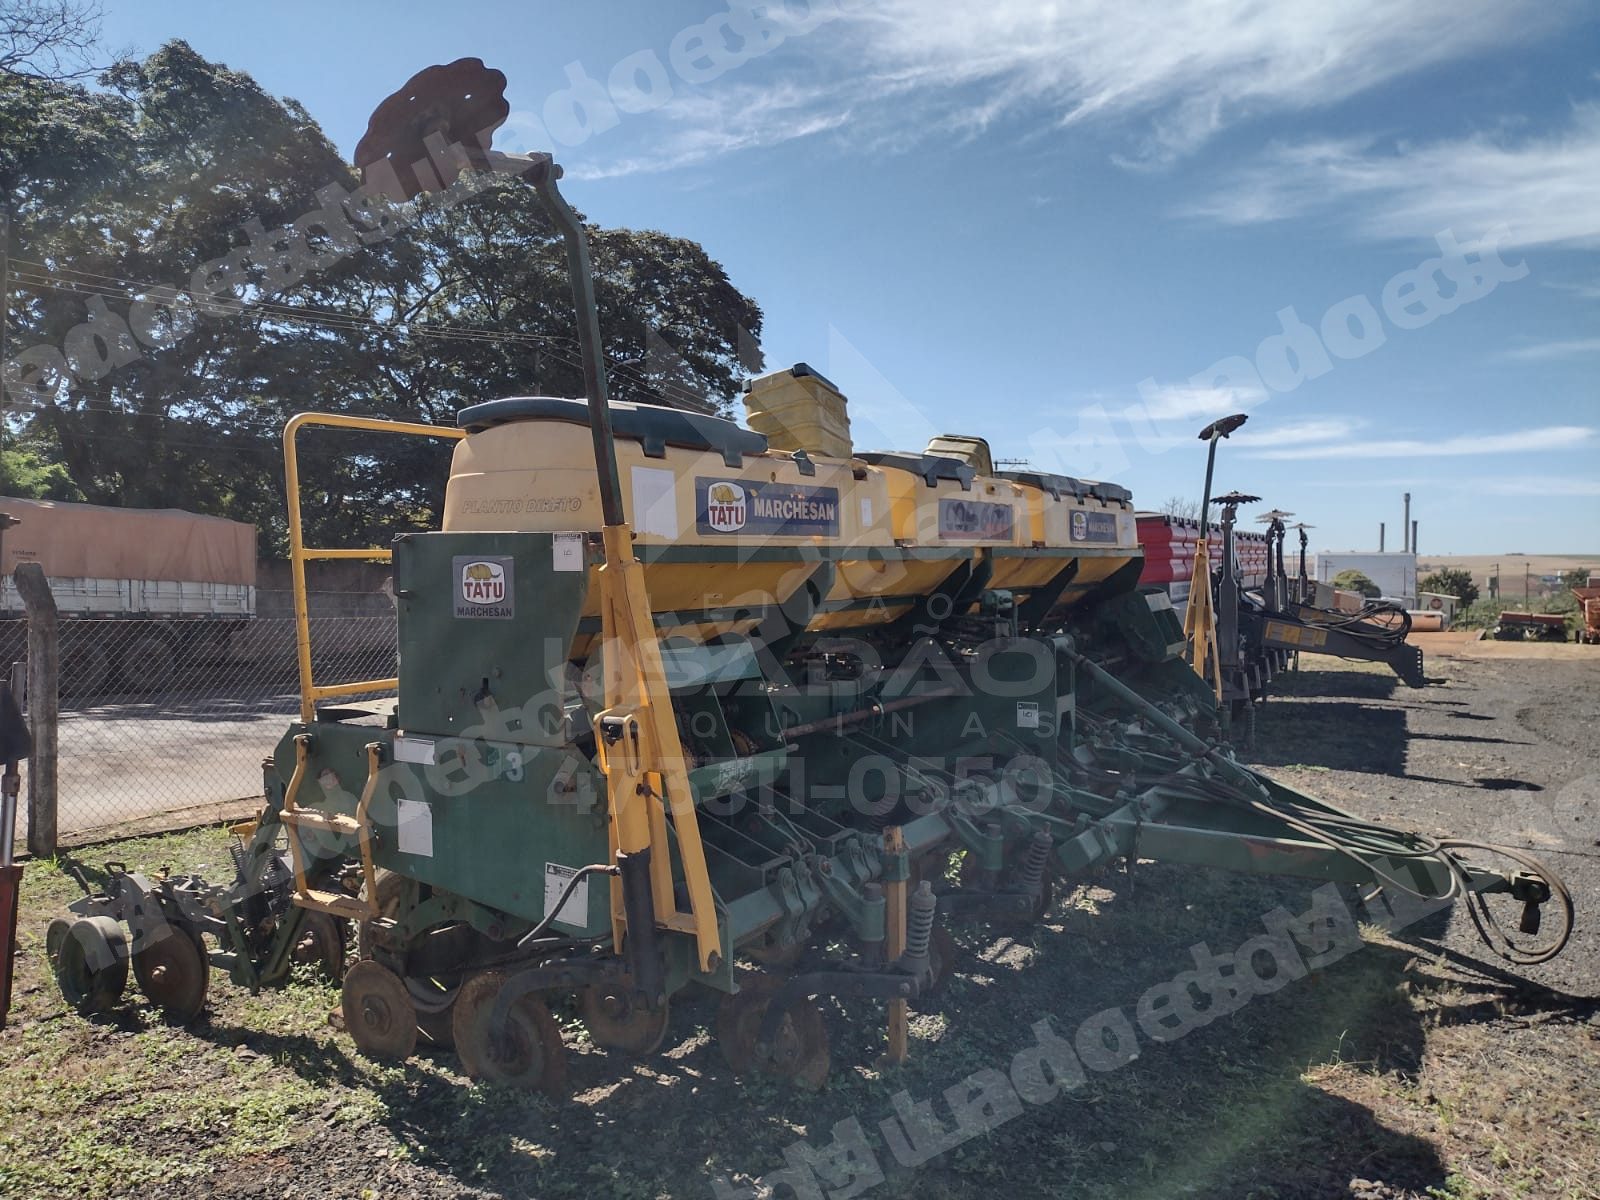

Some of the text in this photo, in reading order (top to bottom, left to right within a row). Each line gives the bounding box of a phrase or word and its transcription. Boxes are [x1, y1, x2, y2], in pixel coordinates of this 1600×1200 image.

[709, 499, 835, 525] TATU MARCHESAN
[464, 582, 503, 599] TATU
[457, 607, 512, 617] MARCHESAN
